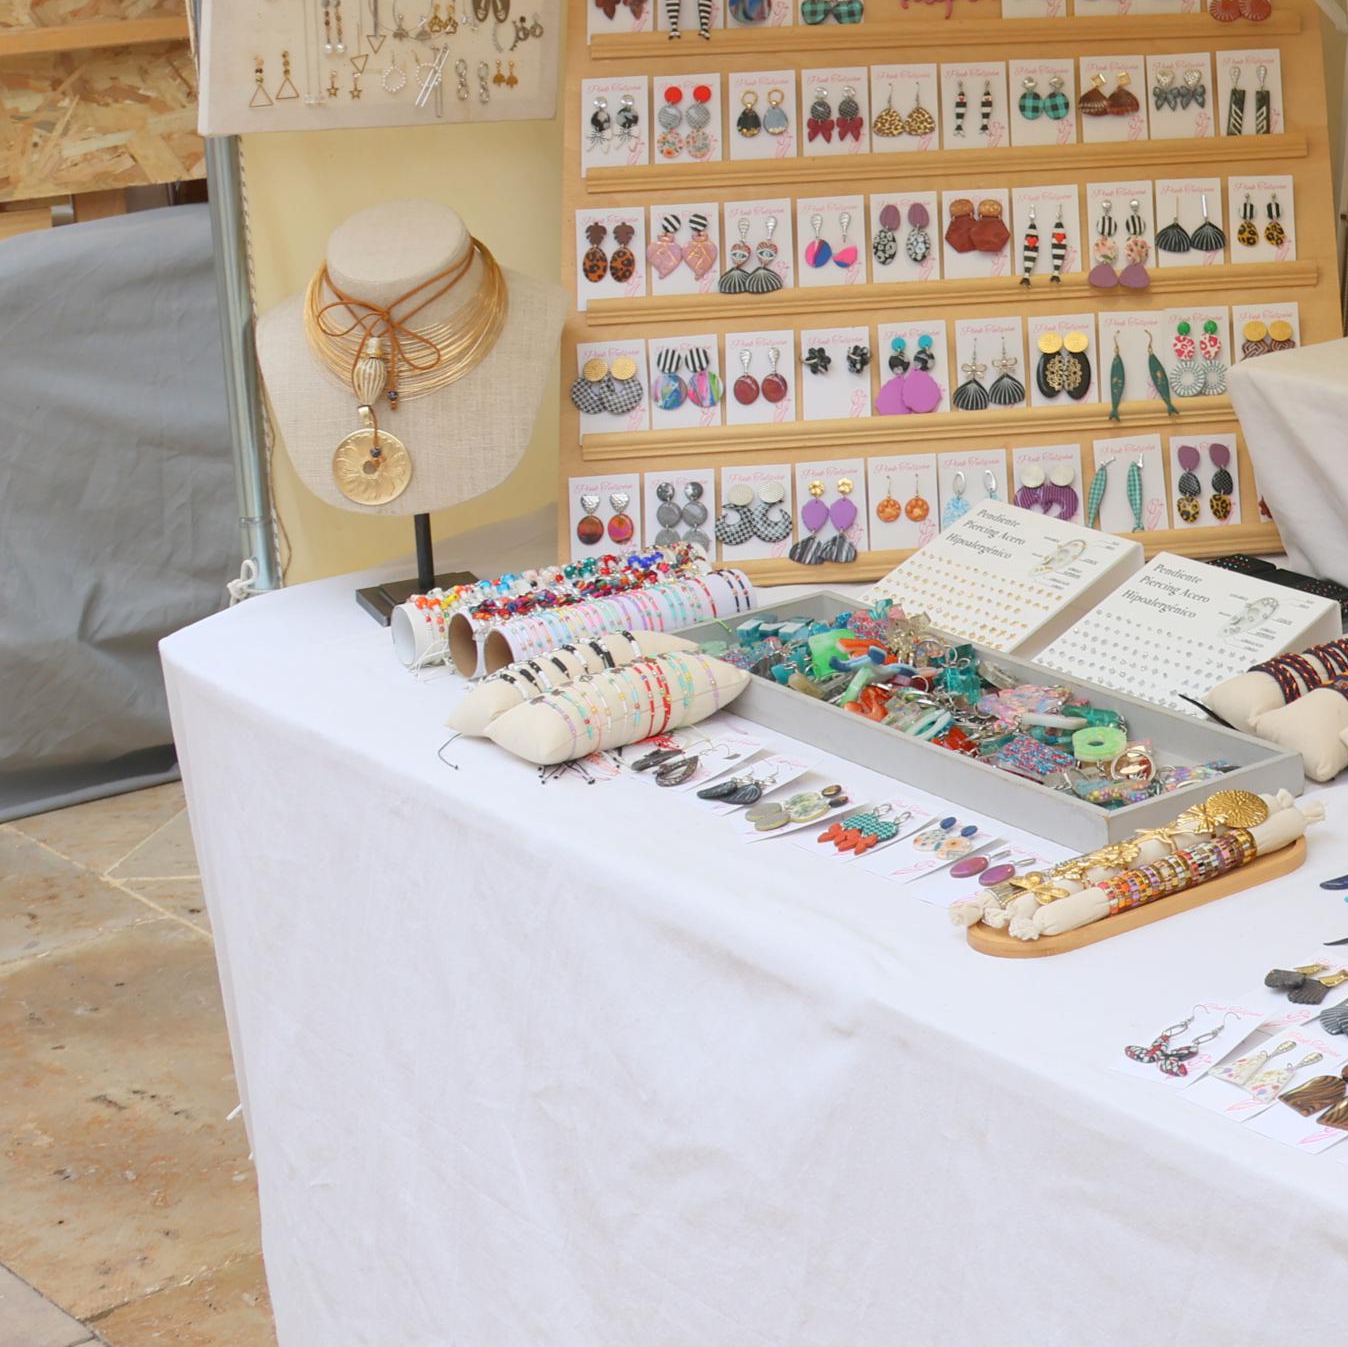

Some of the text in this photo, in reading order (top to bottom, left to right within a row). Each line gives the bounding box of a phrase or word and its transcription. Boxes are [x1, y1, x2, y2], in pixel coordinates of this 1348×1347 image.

[977, 509, 1020, 527] Pendiente
[963, 520, 999, 539] Piercing
[1001, 532, 1026, 545] Acero
[1154, 563, 1203, 584] Pendiente
[1139, 575, 1210, 603] Piercing Acero
